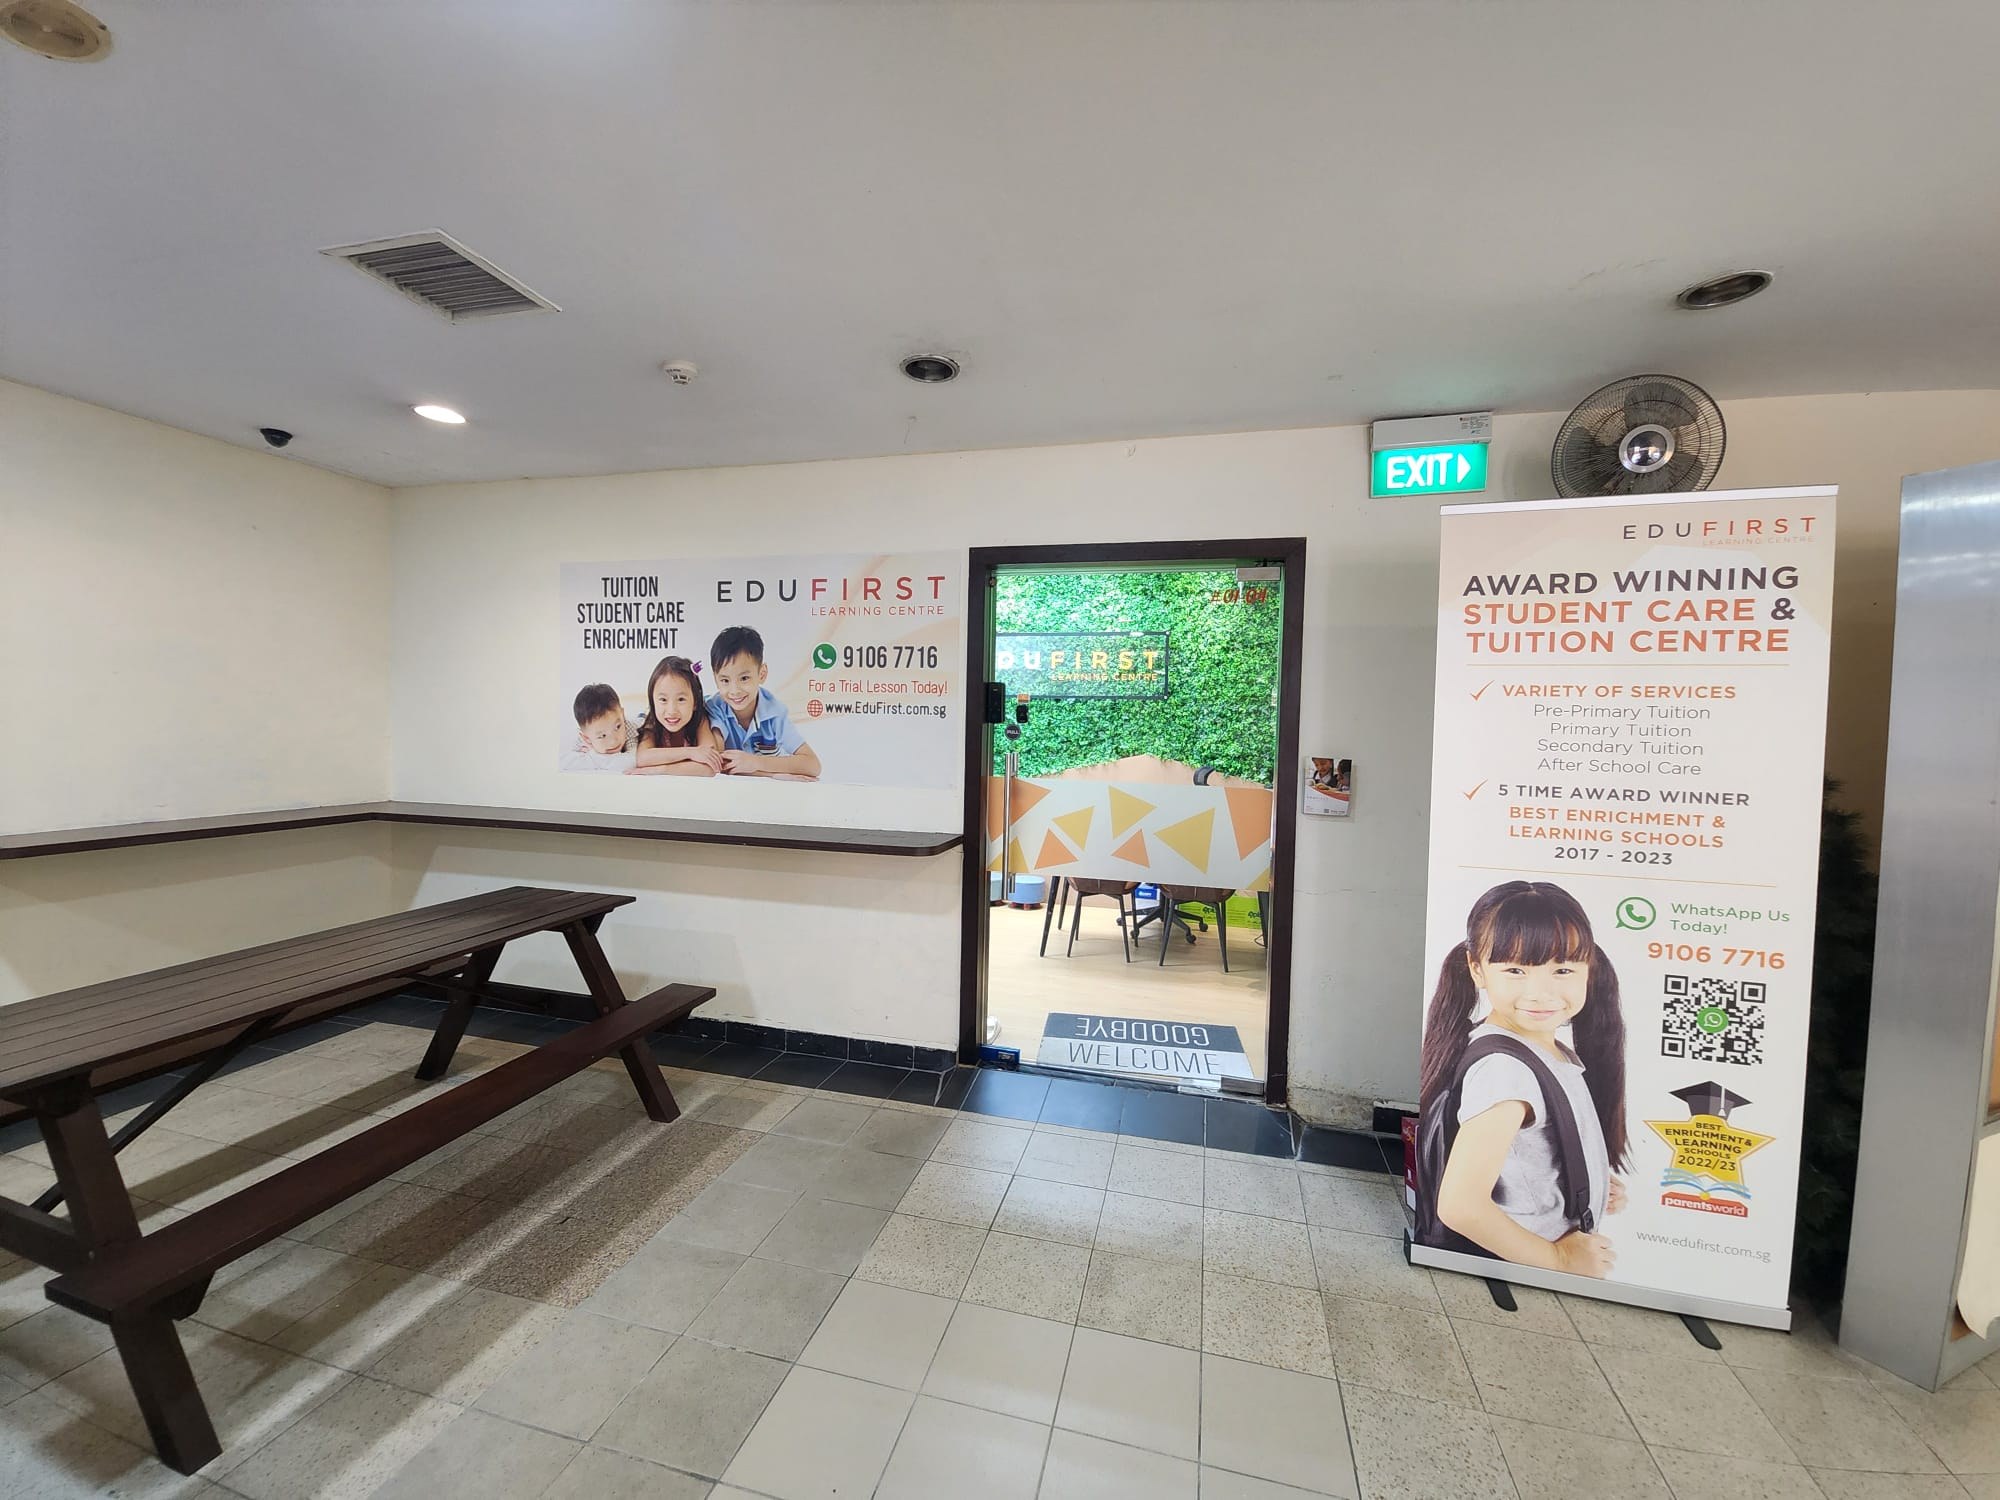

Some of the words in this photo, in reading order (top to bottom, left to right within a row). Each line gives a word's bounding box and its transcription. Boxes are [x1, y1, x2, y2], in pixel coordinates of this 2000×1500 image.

[1387, 453, 1454, 489] EXIT
[1623, 517, 1817, 540] EDUFIRST
[1702, 538, 1760, 546] LEARNING
[1768, 536, 1814, 544] CENTRE
[601, 576, 659, 598] TUITION
[717, 576, 945, 602] EDUFIRST
[1462, 573, 1598, 597] AWARD
[1612, 566, 1799, 593] WINNING
[577, 602, 641, 624] STUDENT
[646, 602, 685, 623] CARE
[811, 607, 881, 616] LEARNING
[889, 606, 944, 615] CENTRE
[1463, 601, 1632, 625] STUDENT
[1647, 598, 1756, 622] CARE
[1770, 597, 1795, 620] &
[584, 628, 678, 649] ENRICHMENT
[1466, 631, 1614, 654] TUITION
[1630, 629, 1789, 653] CENTRE
[843, 646, 887, 669] 9106
[893, 646, 938, 669] 7716
[998, 650, 1158, 670] DUFIRST
[1052, 673, 1109, 682] LEARNING
[1114, 673, 1158, 681] CENTRE
[809, 680, 826, 692] For
[829, 683, 836, 692] a
[839, 680, 863, 693] Trial
[867, 680, 908, 693] Lesson
[911, 681, 948, 697] Today!
[1502, 684, 1587, 698] VARIETY
[1595, 685, 1623, 699] OF
[1631, 685, 1736, 700] SERVICES
[825, 701, 946, 719] www.EduFirst.com.sg
[1534, 704, 1640, 720] Pre-Primary
[1646, 705, 1711, 720] Tuition
[1550, 722, 1619, 738] Primary
[1626, 723, 1692, 738] Tuition
[1537, 739, 1633, 756] Secondary
[1639, 740, 1704, 756] Tuition
[1538, 757, 1583, 773] After
[1588, 759, 1651, 775] School
[1657, 761, 1702, 776] Care
[1498, 784, 1508, 797] 5
[1516, 785, 1563, 799] TIME
[1570, 787, 1651, 802] AWARD
[1659, 790, 1750, 807] WINNER
[1509, 807, 1559, 821] BEST
[1567, 809, 1705, 828] ENRICHMENT
[1712, 815, 1726, 829] &
[1509, 825, 1613, 842] LEARNING
[1621, 831, 1724, 849] SCHOOLS
[1554, 847, 1599, 862] 2017
[1621, 850, 1673, 866] 2023
[1671, 903, 1763, 922] WhatsApp
[1768, 910, 1790, 922] Us
[1670, 920, 1728, 935] Today!
[1648, 942, 1712, 964] 9106
[1722, 948, 1786, 970] 7716
[1075, 1017, 1210, 1047] GOODBYE
[1069, 1042, 1219, 1074] WELCOME
[1695, 1122, 1723, 1131] BEST
[1665, 1128, 1744, 1144] ENRICHMENT
[1744, 1139, 1753, 1147] &
[1674, 1138, 1742, 1154] LEARNING
[1684, 1147, 1731, 1160] SCHOOLS
[1678, 1155, 1736, 1172] 2022/23
[1664, 1197, 1745, 1216] parentsworld
[1636, 1230, 1772, 1263] www.edufirst.com.sg
